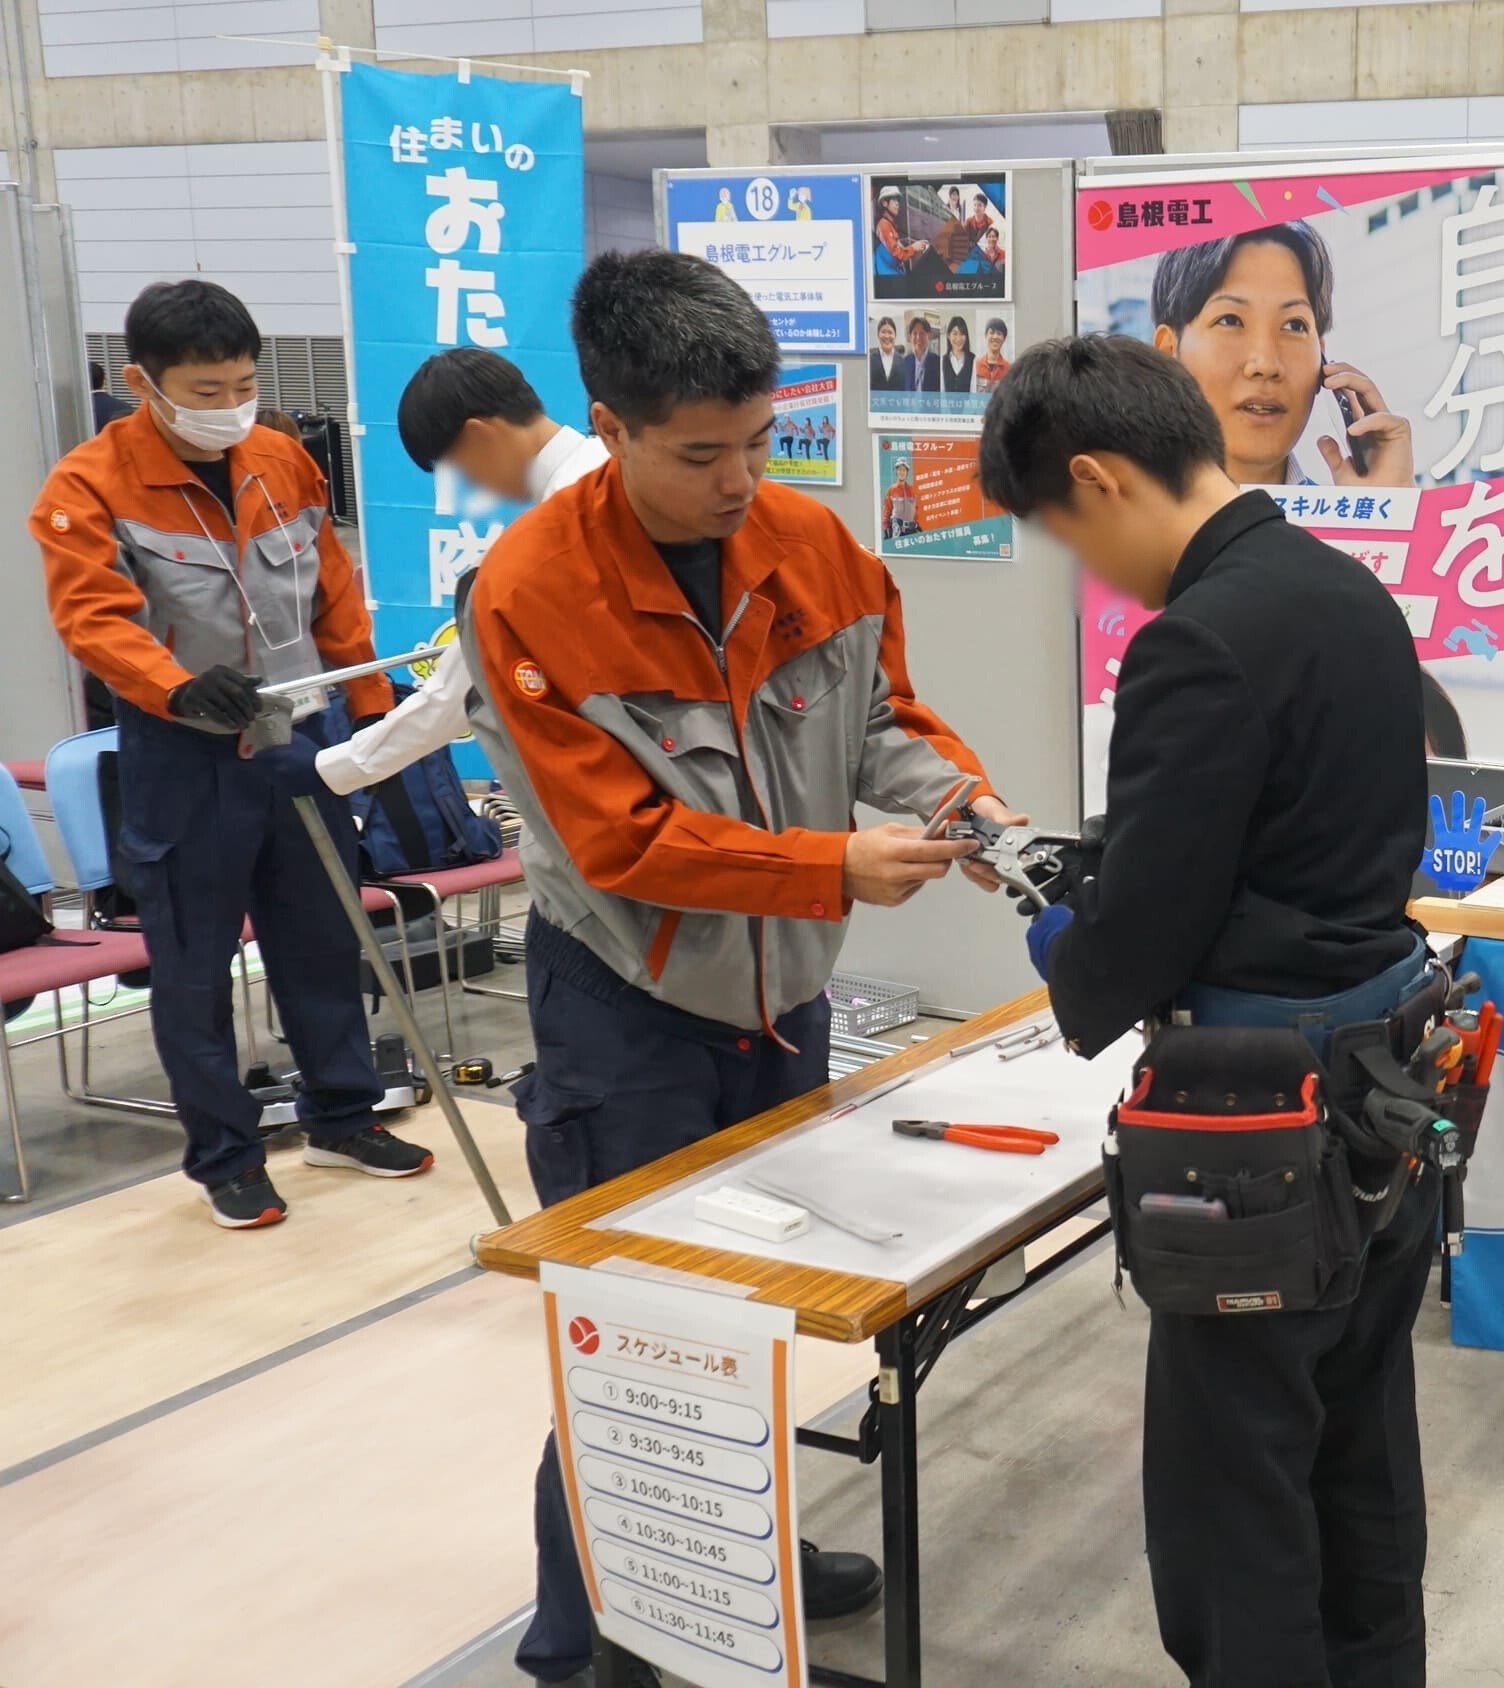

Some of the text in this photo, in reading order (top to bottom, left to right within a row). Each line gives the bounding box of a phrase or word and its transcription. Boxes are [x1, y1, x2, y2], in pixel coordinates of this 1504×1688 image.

[389, 116, 535, 171] 住まいの
[750, 186, 774, 212] 18
[1116, 198, 1213, 229] 島根電工
[706, 241, 827, 263] 島根電工グループ
[750, 291, 823, 302] 使った電気工事体験
[1433, 848, 1481, 876] STOP!
[617, 1333, 739, 1379] スケジュール表
